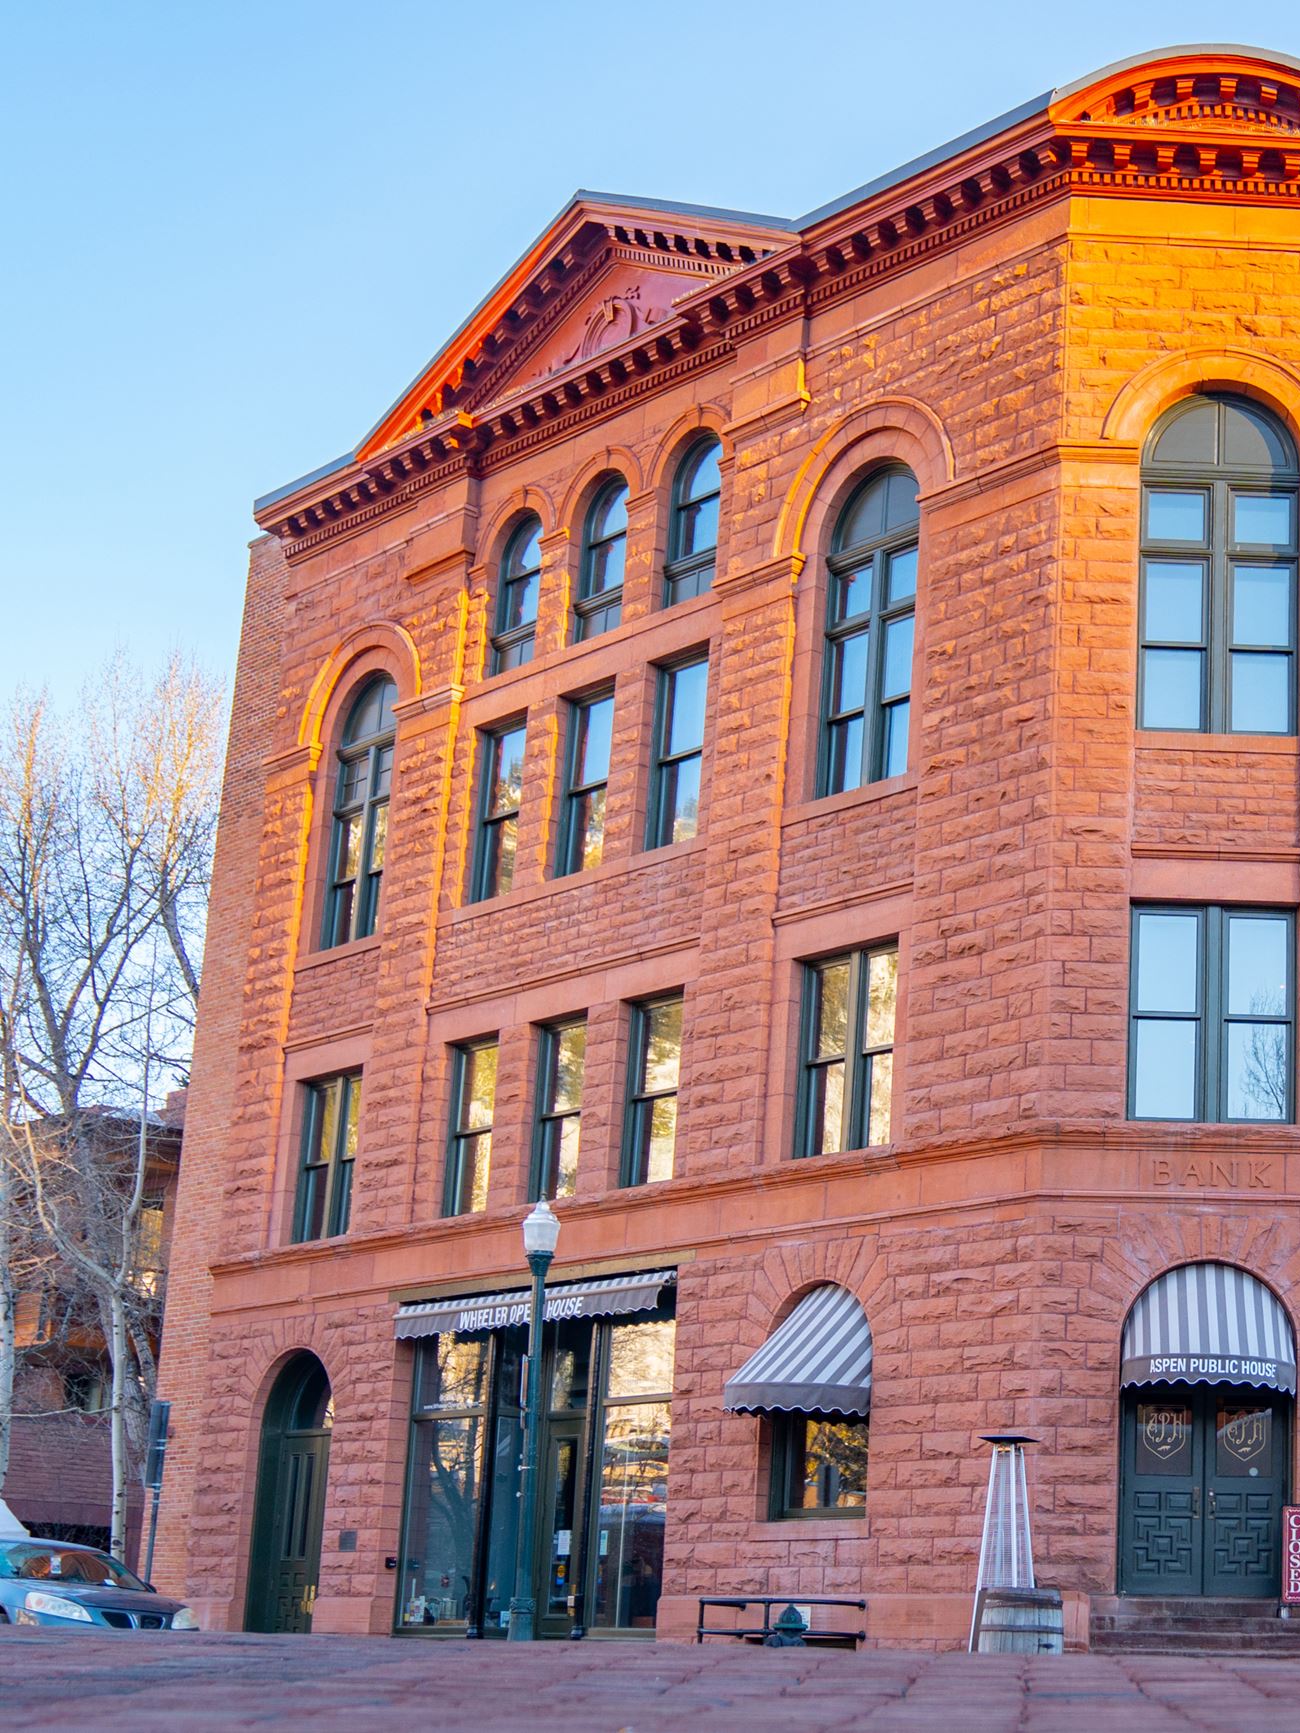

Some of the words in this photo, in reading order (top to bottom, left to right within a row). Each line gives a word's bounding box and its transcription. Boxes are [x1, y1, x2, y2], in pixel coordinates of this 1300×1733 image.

[1153, 1160, 1271, 1188] BANK
[460, 1305, 508, 1328] WHEELER
[509, 1303, 531, 1322] OPE
[546, 1296, 584, 1318] HOUSE
[1149, 1358, 1186, 1373] ASPEN
[1190, 1359, 1238, 1374] PUBLIC
[1241, 1360, 1277, 1377] HOUSE
